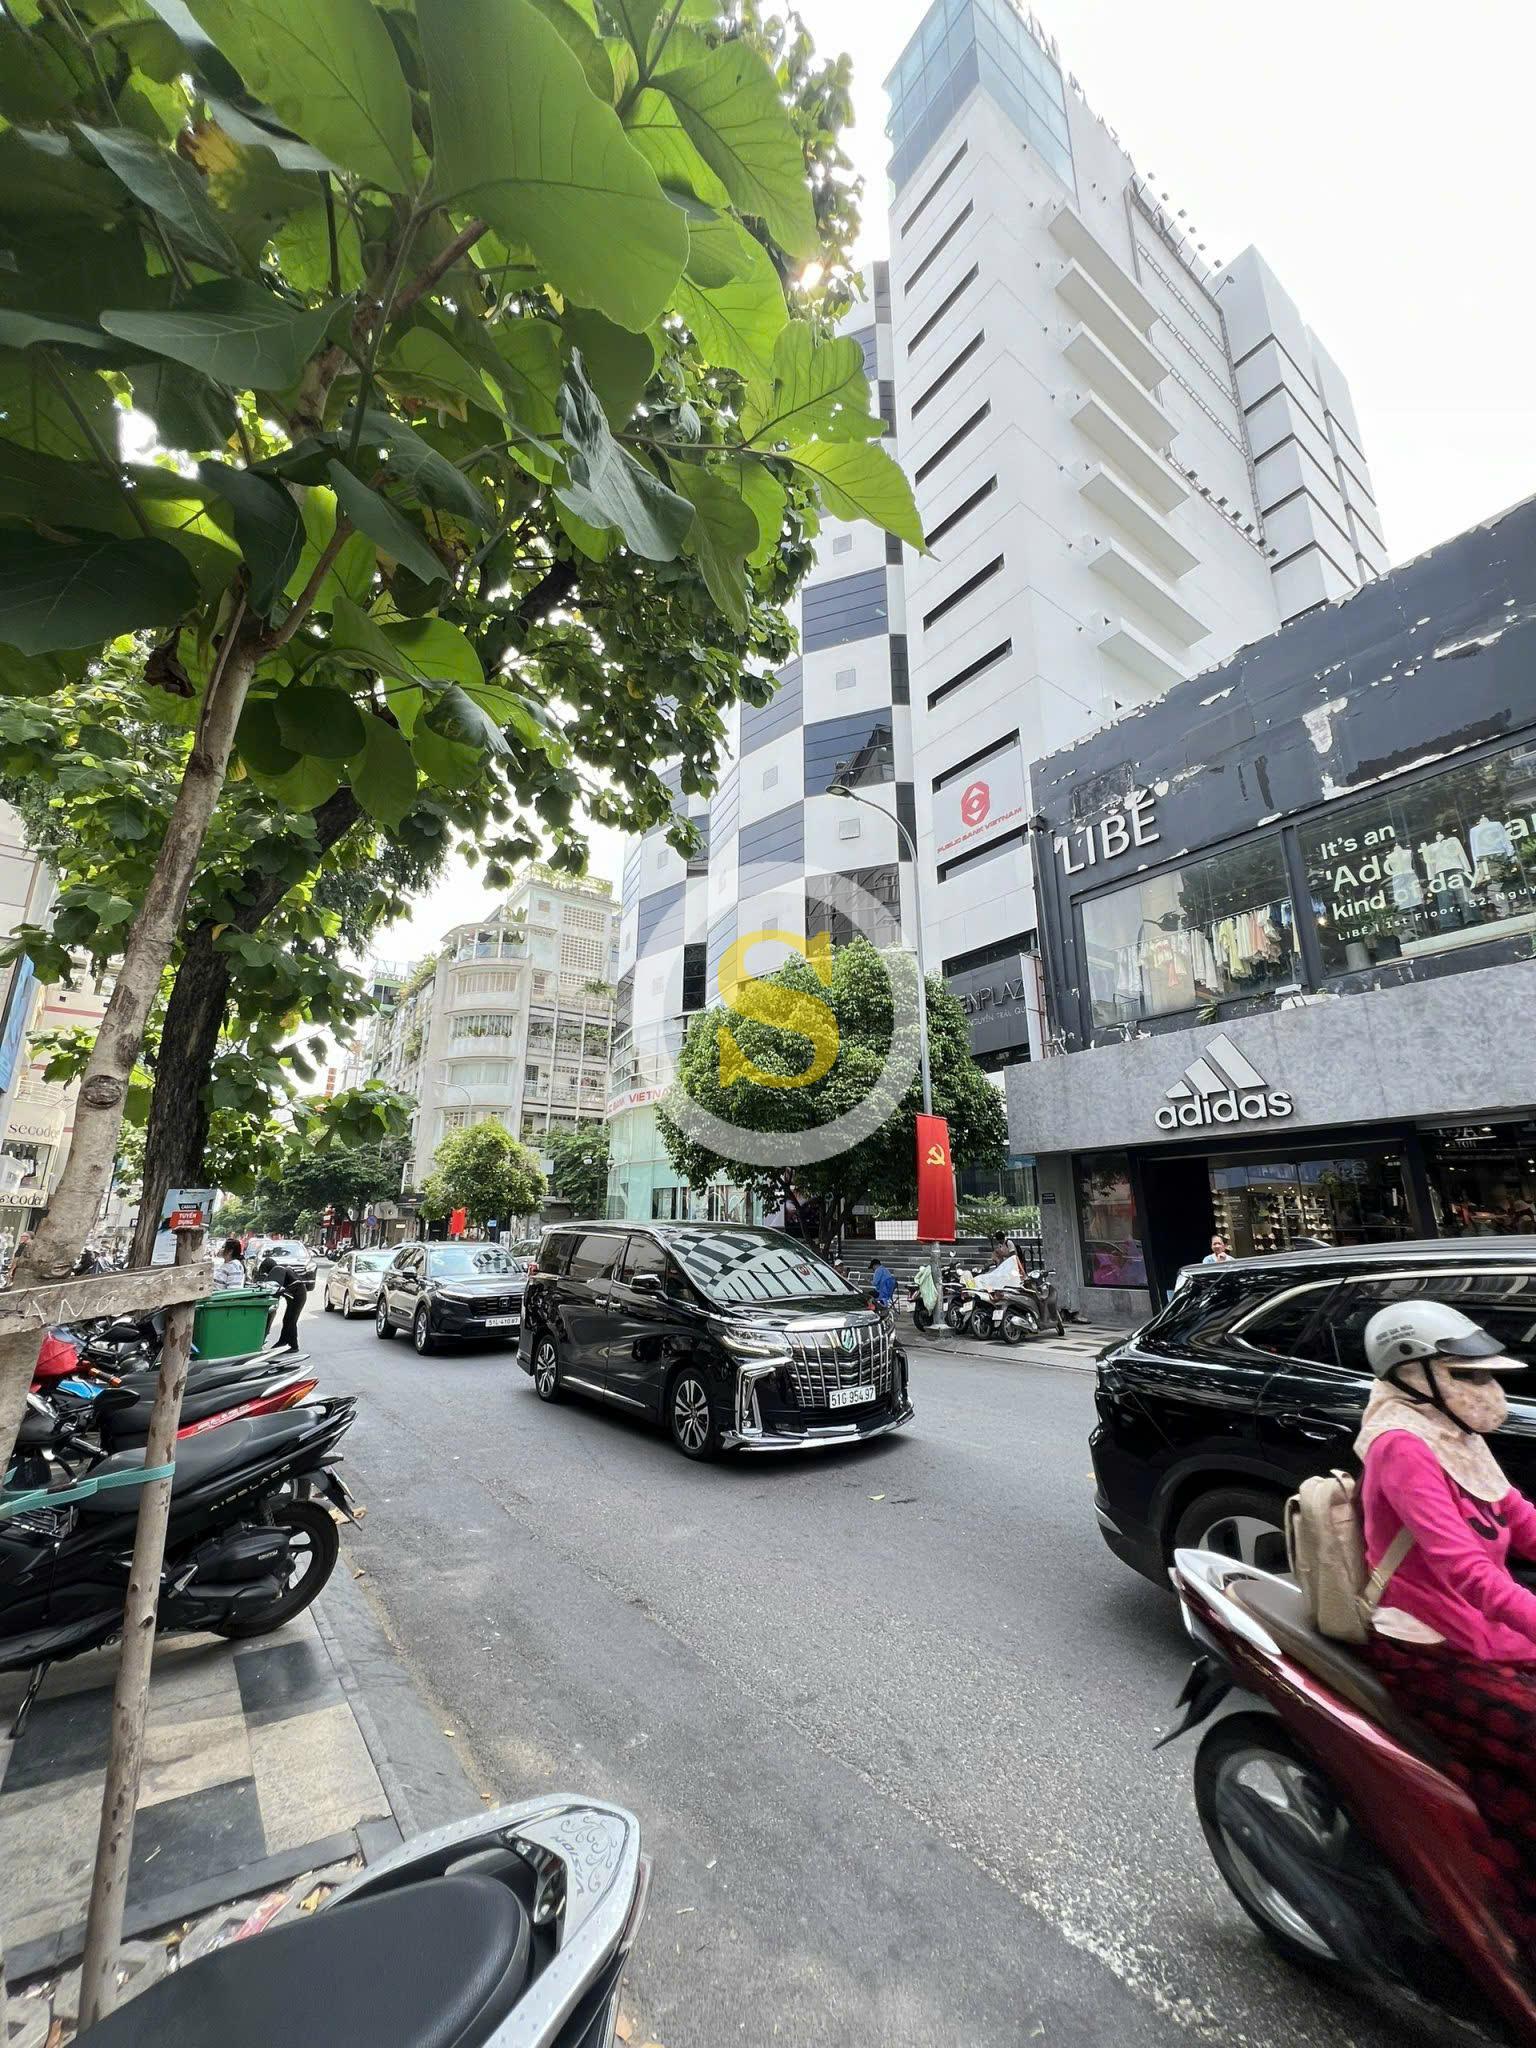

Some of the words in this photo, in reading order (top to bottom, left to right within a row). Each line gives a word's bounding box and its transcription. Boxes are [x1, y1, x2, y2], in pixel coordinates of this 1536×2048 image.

[962, 826, 984, 841] BANK
[984, 807, 1022, 830] VIETNAM
[1062, 789, 1160, 875] LIBÉ
[1364, 825, 1396, 846] an
[1332, 890, 1388, 921] kind
[1429, 861, 1491, 893] day!
[1155, 1090, 1293, 1130] adidas
